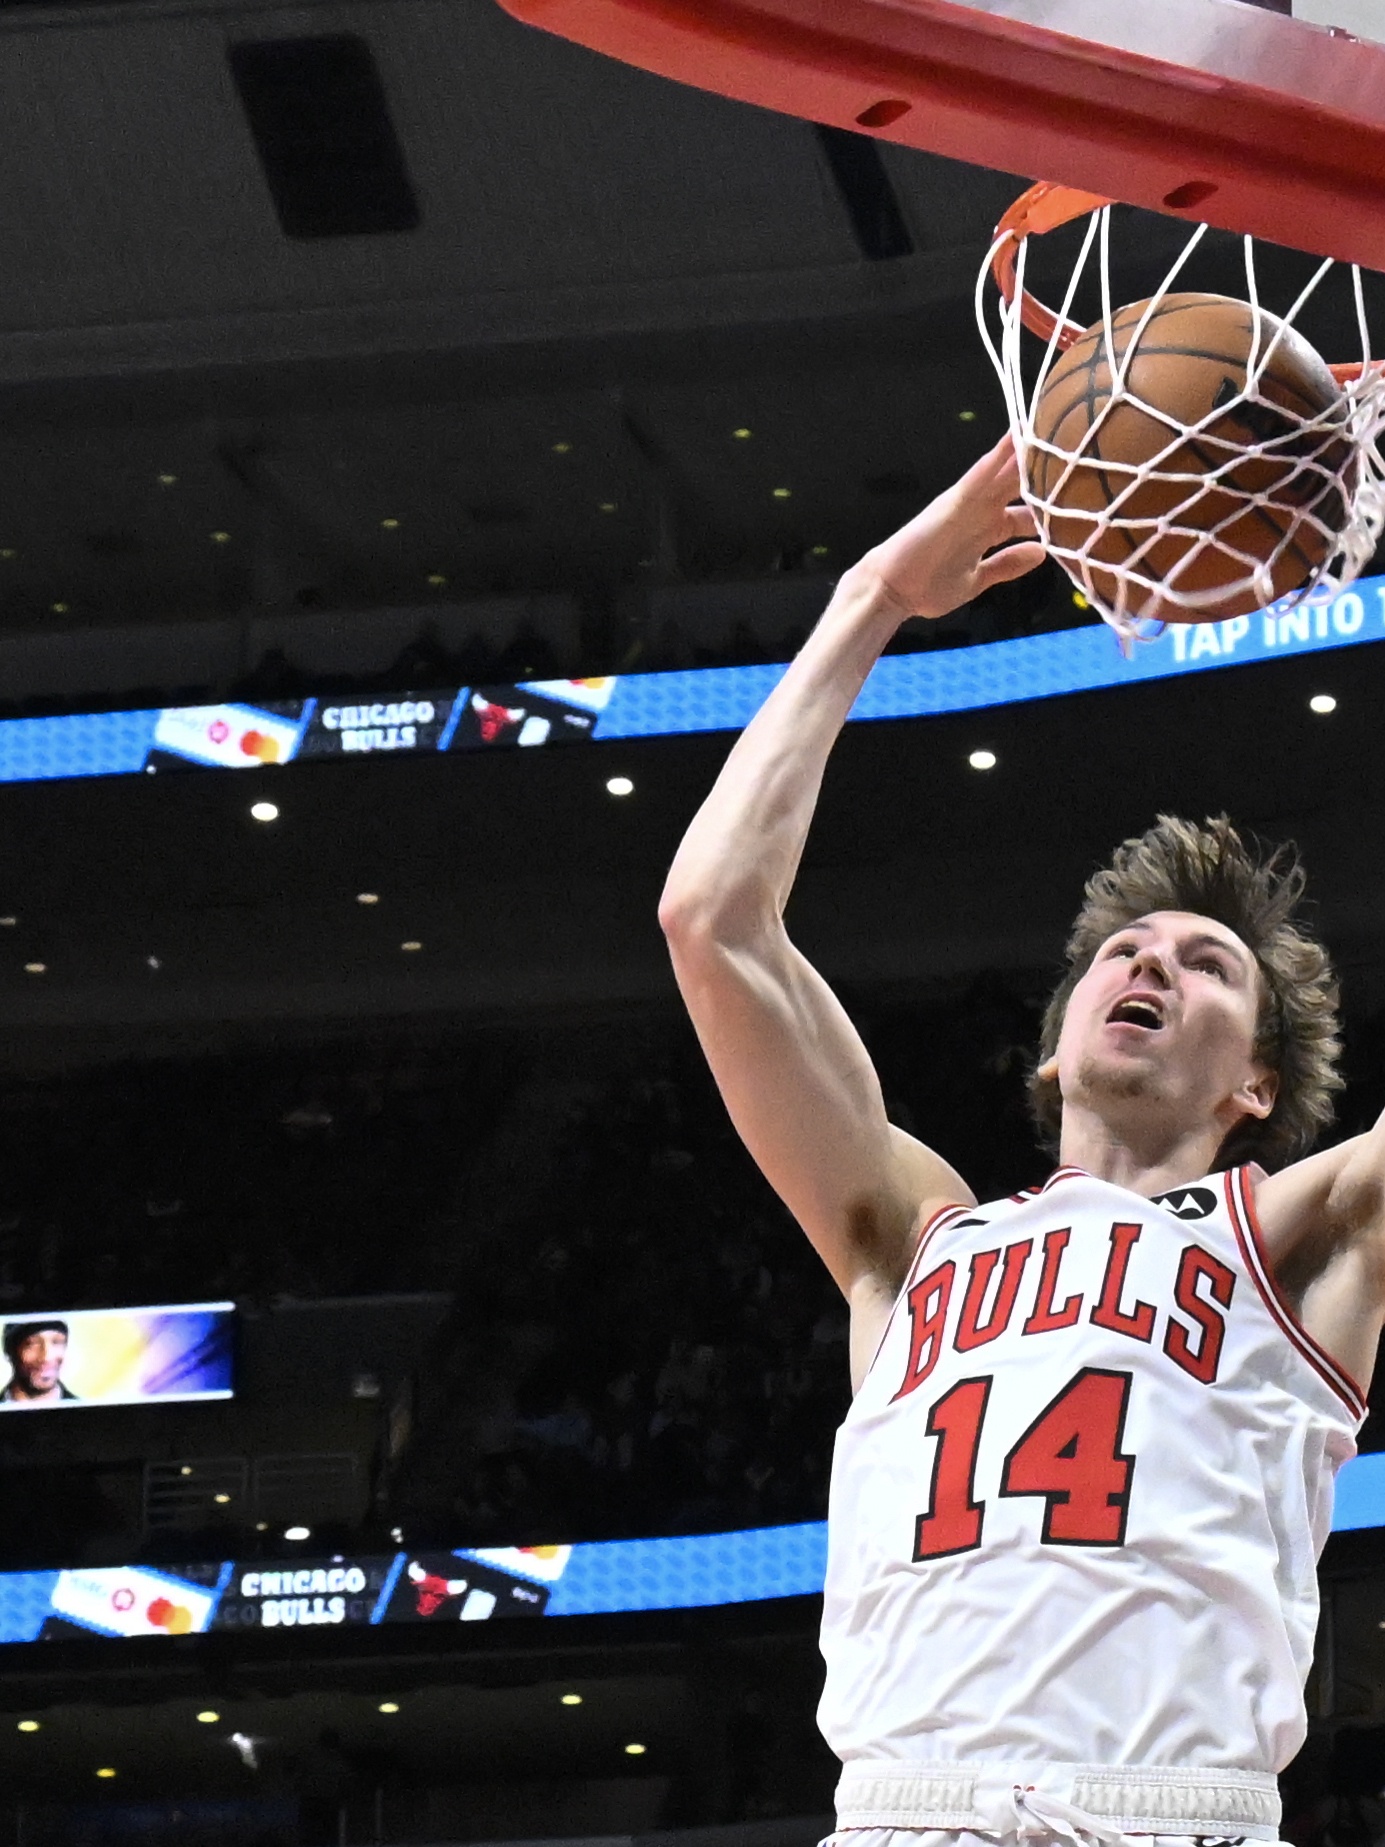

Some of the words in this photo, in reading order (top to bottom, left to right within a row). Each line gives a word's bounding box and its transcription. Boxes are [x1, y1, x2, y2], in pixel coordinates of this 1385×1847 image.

[1169, 613, 1250, 662] TAP
[1263, 593, 1365, 647] INTO
[322, 700, 435, 730] CHICAGO
[341, 725, 417, 752] BULLS
[888, 1222, 1237, 1405] BULLS
[911, 1366, 1137, 1563] 14
[241, 1567, 366, 1597] CHICAGO
[261, 1596, 345, 1627] BULLS
